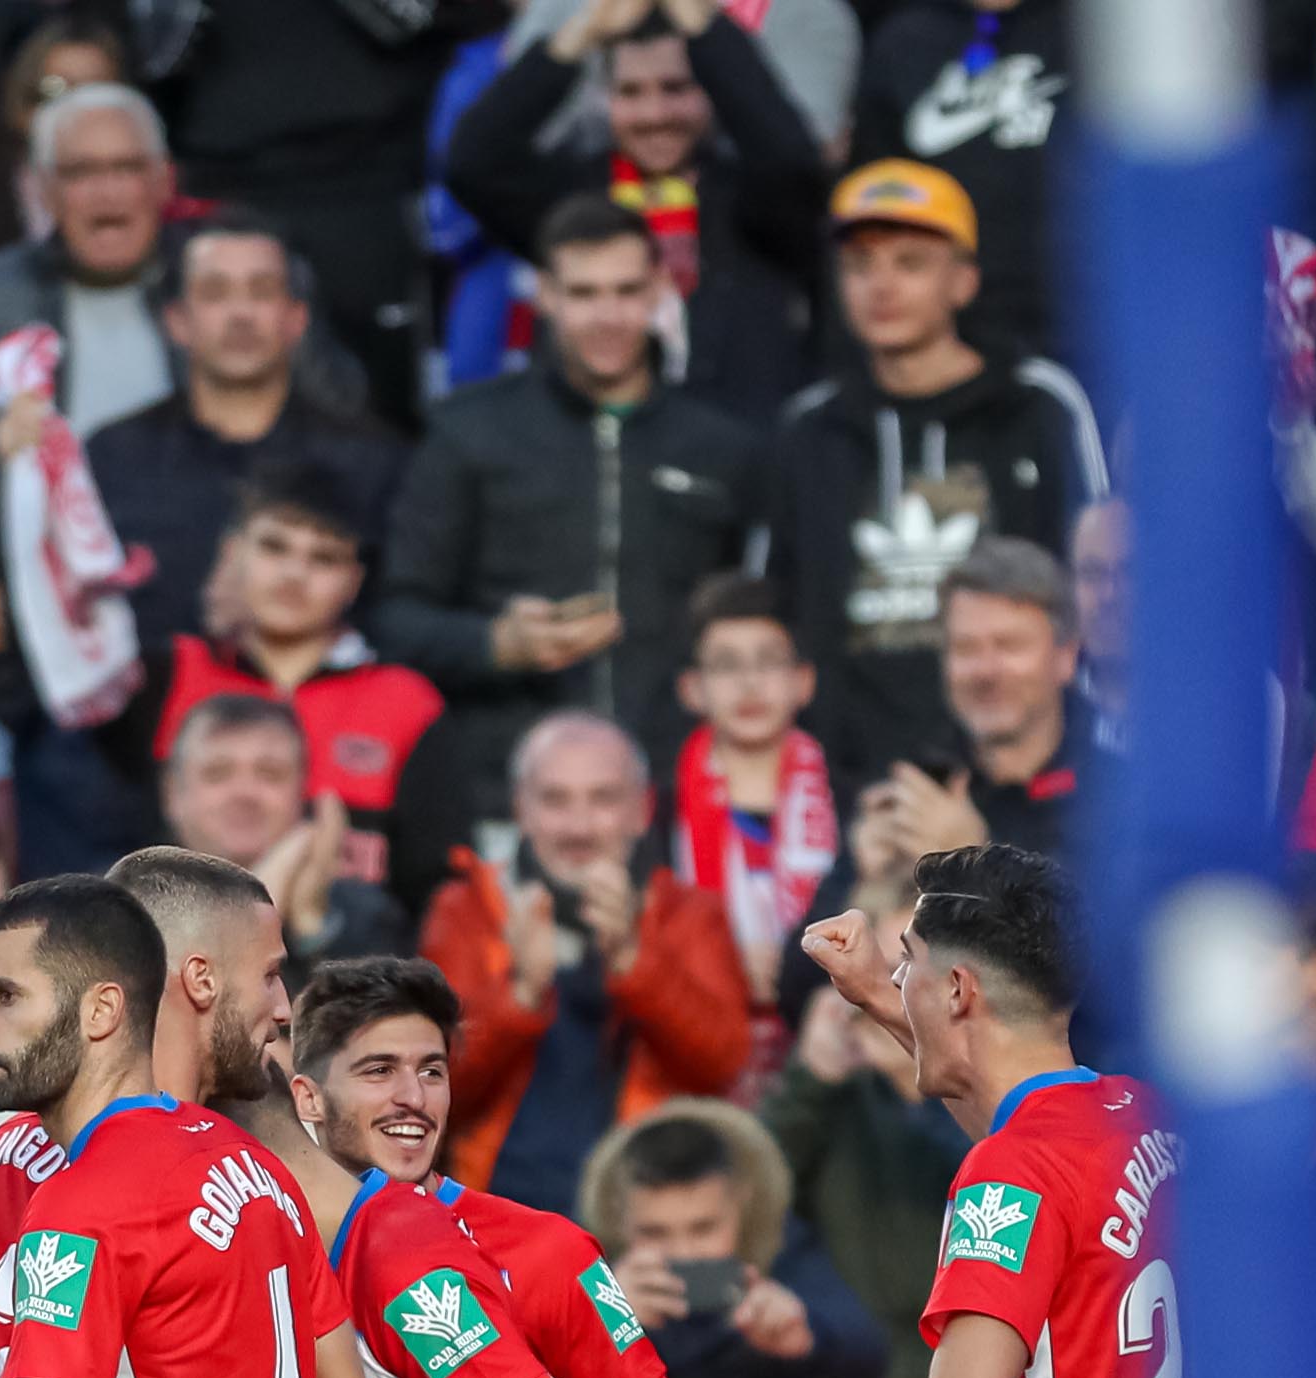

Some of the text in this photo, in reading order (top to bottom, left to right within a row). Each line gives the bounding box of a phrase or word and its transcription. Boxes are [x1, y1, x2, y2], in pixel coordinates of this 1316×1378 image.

[955, 1248, 1001, 1262] GRANADA
[974, 1239, 1018, 1261] RURAL
[21, 1307, 55, 1323] ANADA
[28, 1295, 75, 1319] RURAL
[428, 1321, 490, 1371] CAJA RURAL
